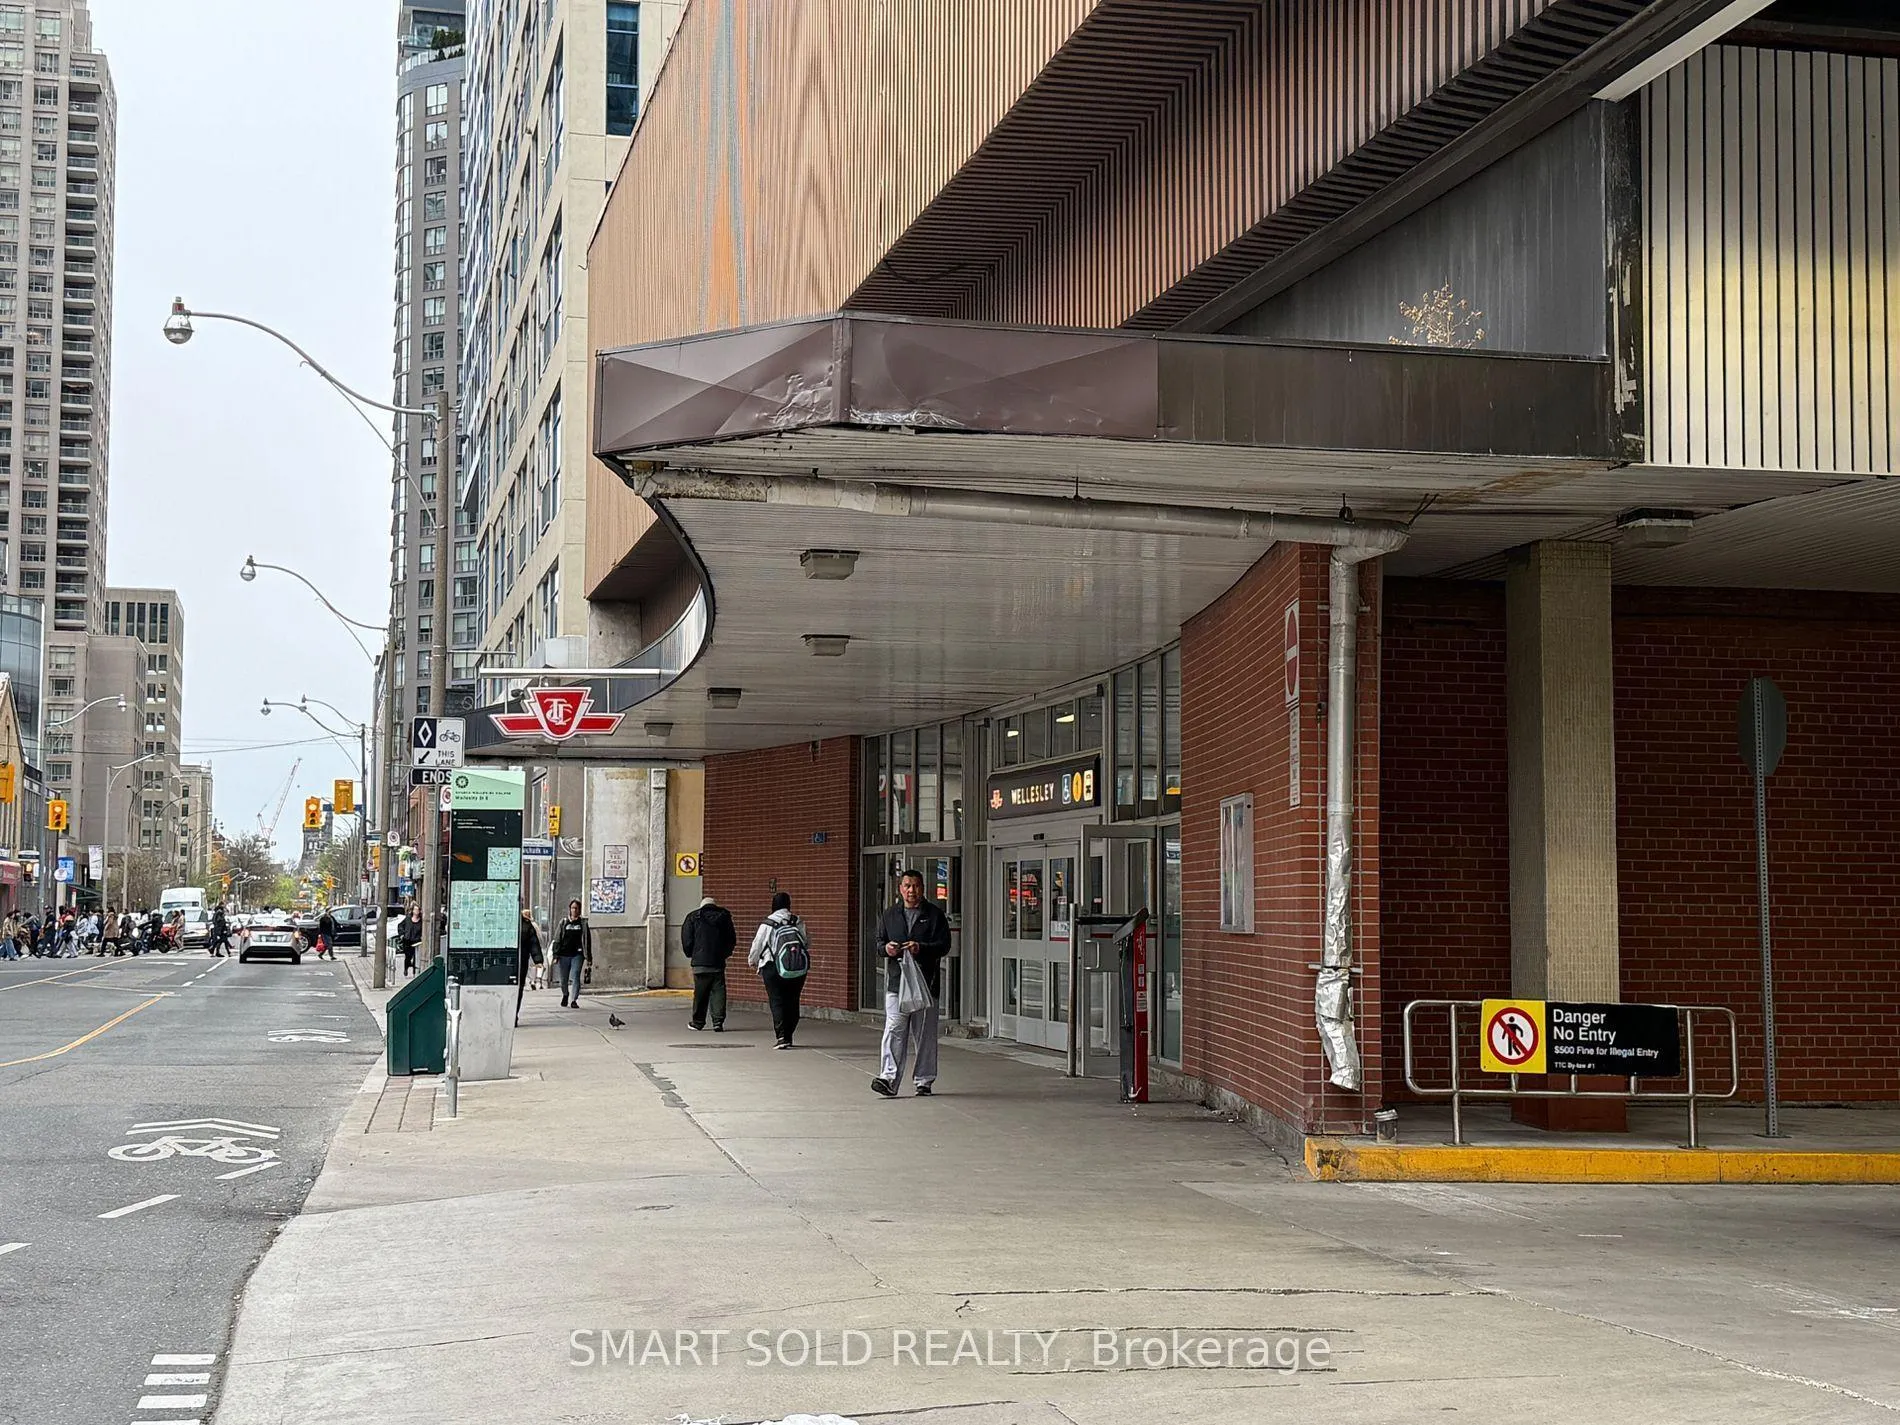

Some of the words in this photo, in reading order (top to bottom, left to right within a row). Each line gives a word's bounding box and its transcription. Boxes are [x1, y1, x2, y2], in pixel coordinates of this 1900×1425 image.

[437, 750, 455, 758] THIS
[435, 759, 456, 767] LANE
[422, 771, 452, 783] ENDS
[1011, 782, 1054, 805] WELLESLEY
[1553, 1008, 1607, 1027] Danger
[1553, 1026, 1574, 1040] No
[1579, 1027, 1617, 1045] Entry
[1554, 1045, 1575, 1055] $500
[1576, 1046, 1594, 1055] Fine
[1596, 1046, 1607, 1055] for
[1609, 1047, 1635, 1058] Illegal
[1636, 1048, 1659, 1059] Entry
